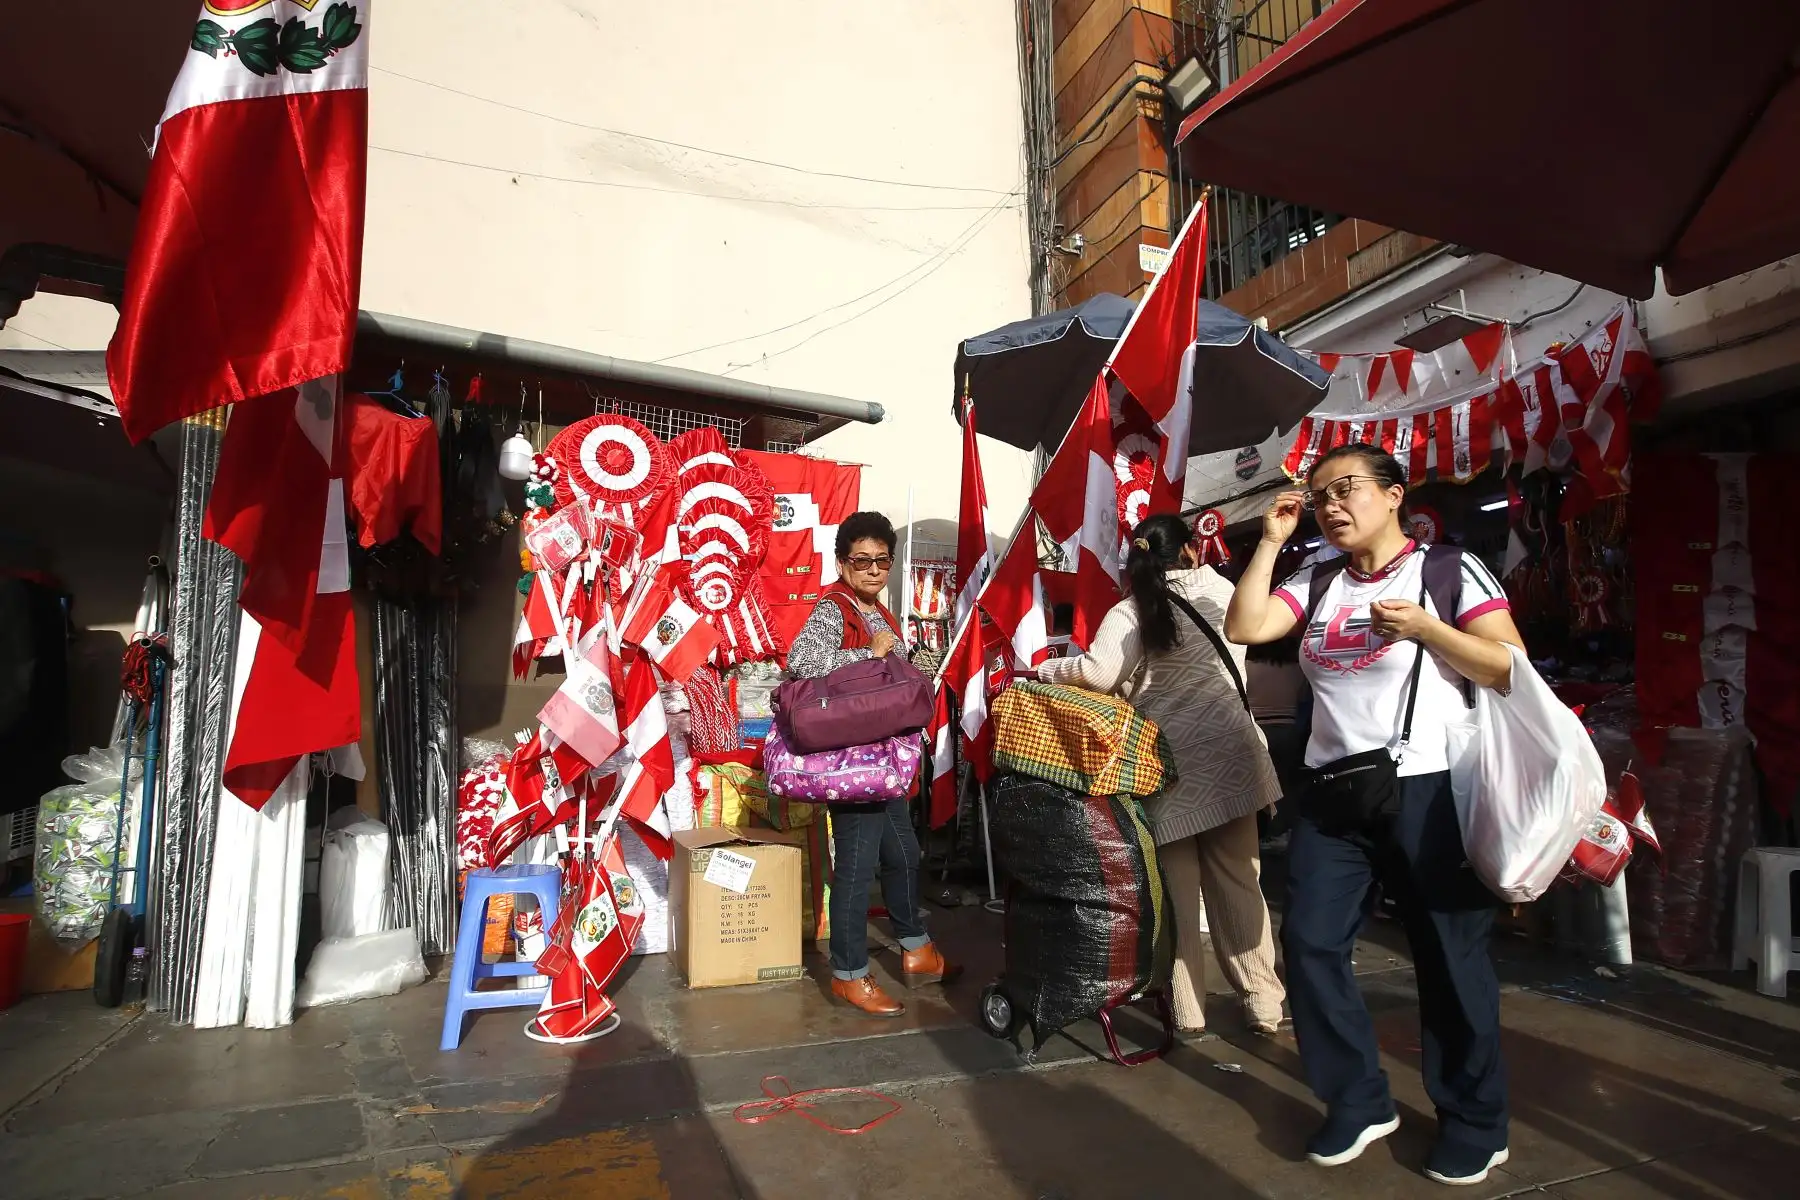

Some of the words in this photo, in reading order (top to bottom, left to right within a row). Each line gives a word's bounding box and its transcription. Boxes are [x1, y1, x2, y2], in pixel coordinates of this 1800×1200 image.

[741, 935, 757, 943] CHINA
[761, 969, 776, 978] JUST
[777, 968, 790, 977] TRY
